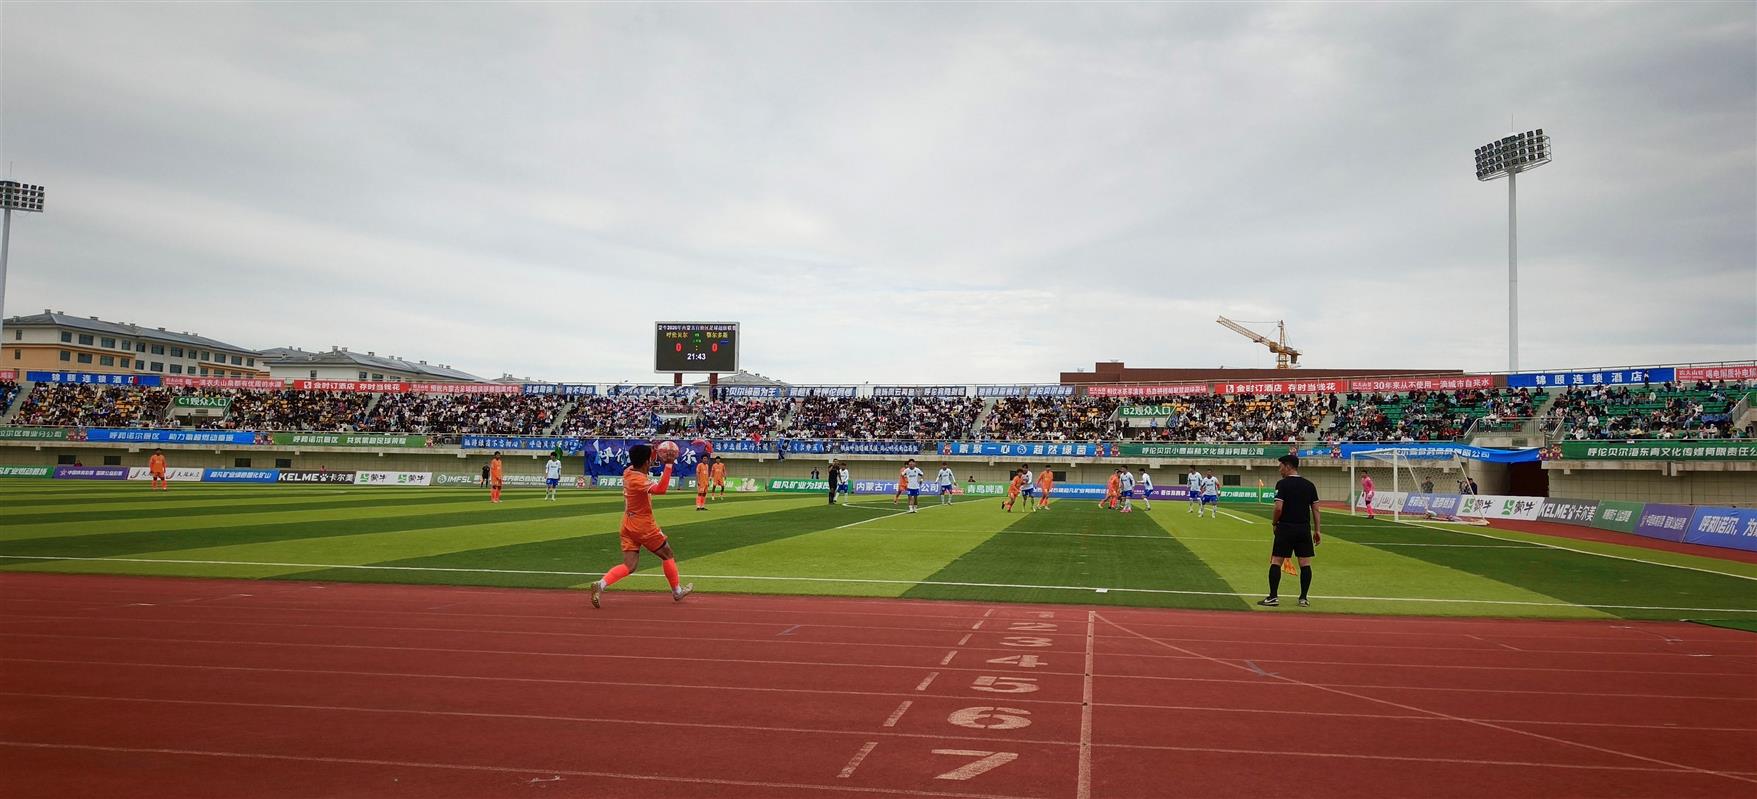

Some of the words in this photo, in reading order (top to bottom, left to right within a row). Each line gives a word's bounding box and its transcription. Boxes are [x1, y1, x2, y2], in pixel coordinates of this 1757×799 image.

[676, 343, 682, 352] 0
[711, 343, 718, 352] 0
[279, 473, 320, 482] KELME
[330, 473, 354, 482] 卡尔美
[447, 475, 472, 483] IMFSL
[967, 484, 1004, 494] 青岛啤酒
[1475, 499, 1495, 512] 蒙牛
[1514, 500, 1536, 515] 蒙牛
[1539, 502, 1570, 519] KELME
[1007, 622, 1058, 632] 2
[999, 636, 1053, 647] 3
[985, 654, 1048, 668] 4
[969, 675, 1040, 693] 5
[947, 706, 1032, 730] 6
[931, 748, 1019, 780] 7
